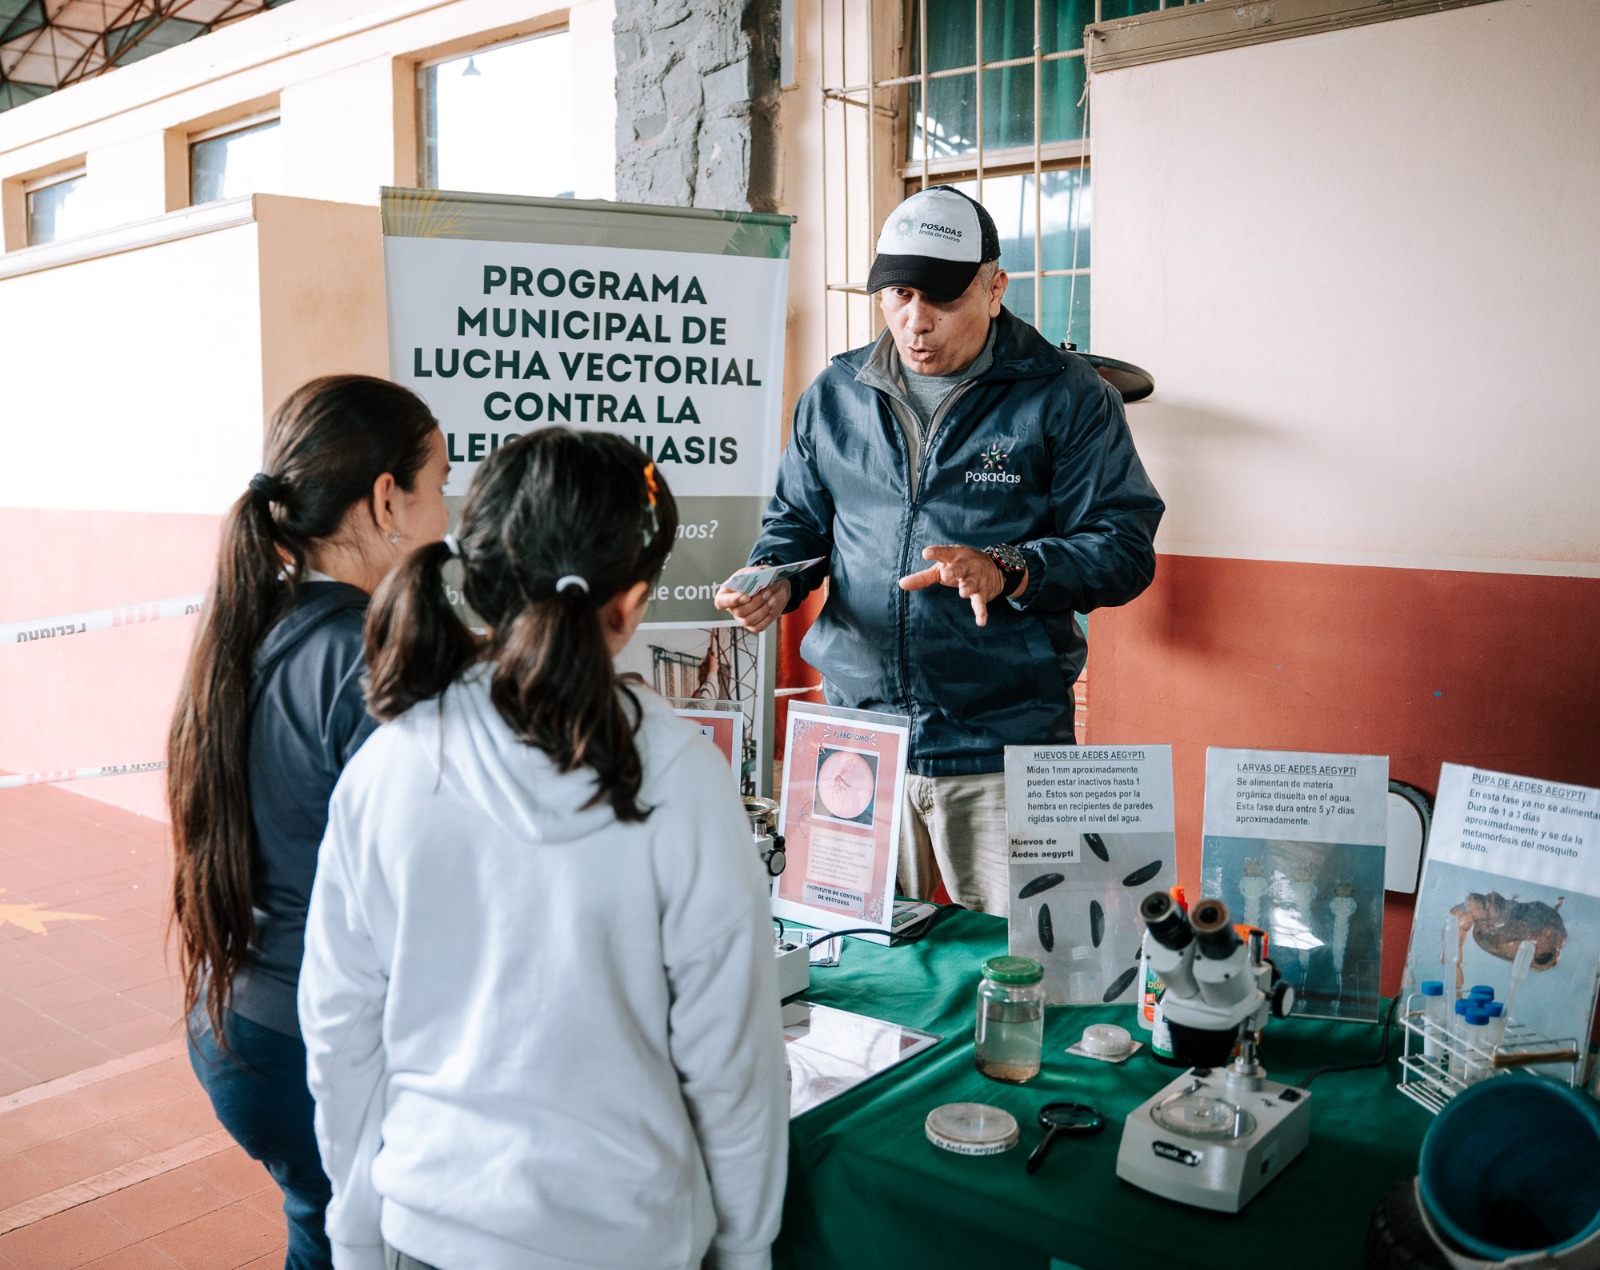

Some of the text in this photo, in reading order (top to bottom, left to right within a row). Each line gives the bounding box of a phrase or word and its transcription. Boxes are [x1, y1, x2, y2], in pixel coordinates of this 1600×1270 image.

[920, 222, 962, 238] POSADAS
[483, 265, 707, 305] PROGRAMA
[457, 306, 726, 345] MUNICIPAL DE
[414, 347, 762, 386] LUCHA VECTORIAL
[484, 391, 701, 424] CONTRA LA
[965, 471, 1021, 484] Posadas
[674, 582, 721, 600] cont
[1034, 751, 1145, 759] HUEVOS DE AEDES AEGYPTI
[1026, 765, 1138, 775] Miden 1mm aproximadamente
[1237, 763, 1356, 775] LARVAS DE AEDES AEGYPTI
[1027, 778, 1055, 787] pueden
[1057, 778, 1076, 786] estar
[1077, 778, 1111, 786] inactivos
[1113, 778, 1134, 786] hasta
[1237, 777, 1333, 789] Se alimentan de materia
[1472, 773, 1586, 801] PUPA DE AEDES AEGYPTI
[1027, 789, 1044, 798] año.
[1046, 790, 1067, 798] Estos
[1085, 790, 1117, 799] pegados
[1119, 791, 1132, 799] por
[1133, 789, 1140, 797] la
[1236, 791, 1271, 800] orgánica
[1274, 791, 1305, 800] disuelta
[1320, 793, 1327, 801] el
[1469, 788, 1481, 798] En
[1482, 793, 1500, 802] esta
[1502, 794, 1520, 805] fase
[1521, 800, 1532, 808] ya
[1534, 801, 1545, 810] no
[1547, 804, 1558, 812] se
[1027, 802, 1056, 811] hembra
[1069, 802, 1110, 812] recipientes
[1112, 802, 1122, 810] de
[1123, 802, 1154, 811] paredes
[1236, 801, 1254, 811] Esta
[1256, 802, 1273, 812] fase
[1275, 803, 1294, 812] dura
[1296, 805, 1317, 813] entre
[1467, 801, 1487, 813] Dura
[1489, 805, 1499, 815] de
[1056, 815, 1078, 823] sobre
[1079, 814, 1086, 822] el
[1088, 814, 1106, 822] nivel
[1107, 814, 1119, 822] del
[1121, 815, 1142, 824] agua.
[1236, 815, 1311, 826] aproximadamente.
[1465, 815, 1583, 845] aproximadamente y se da la
[1011, 838, 1044, 846] Huevos
[1462, 828, 1578, 858] metamorfosis del mosquito
[1041, 850, 1074, 859] aegypti
[807, 884, 832, 895] INSTITUTO
[840, 892, 863, 902] CONTROL
[825, 896, 850, 906] VECTORES
